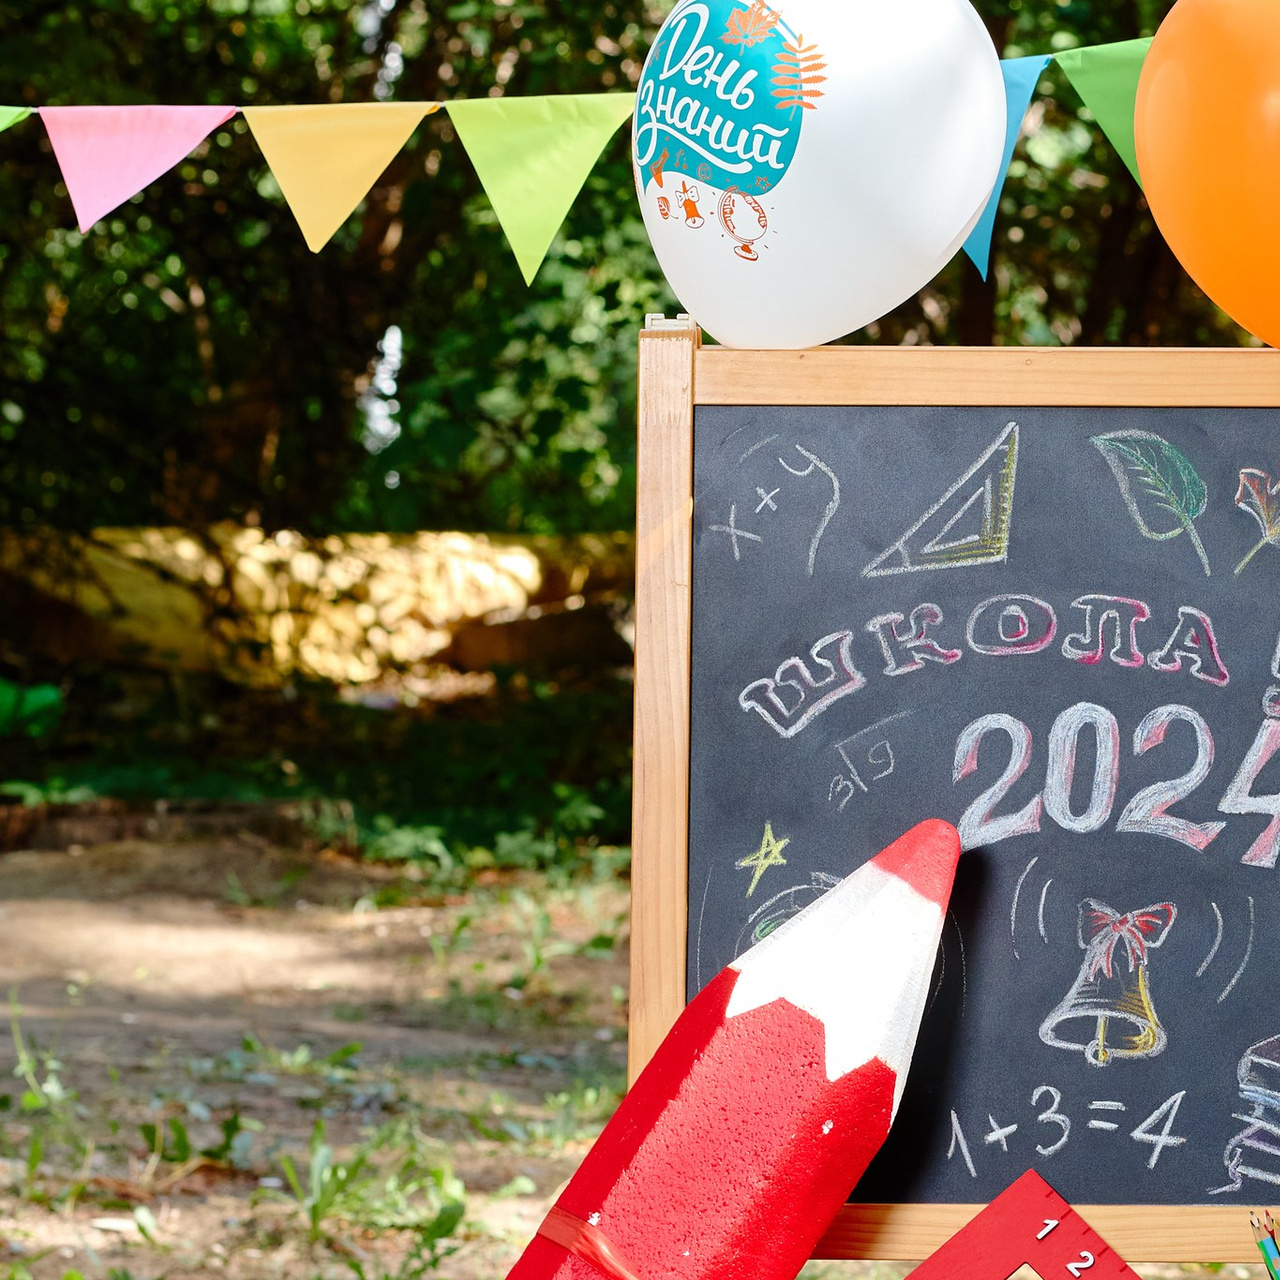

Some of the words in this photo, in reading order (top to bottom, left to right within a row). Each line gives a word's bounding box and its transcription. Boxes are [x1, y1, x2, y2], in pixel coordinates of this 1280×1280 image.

[659, 2, 758, 110] День
[636, 79, 790, 175] знаний
[1036, 1218, 1060, 1240] 1
[1066, 1250, 1095, 1278] 2
